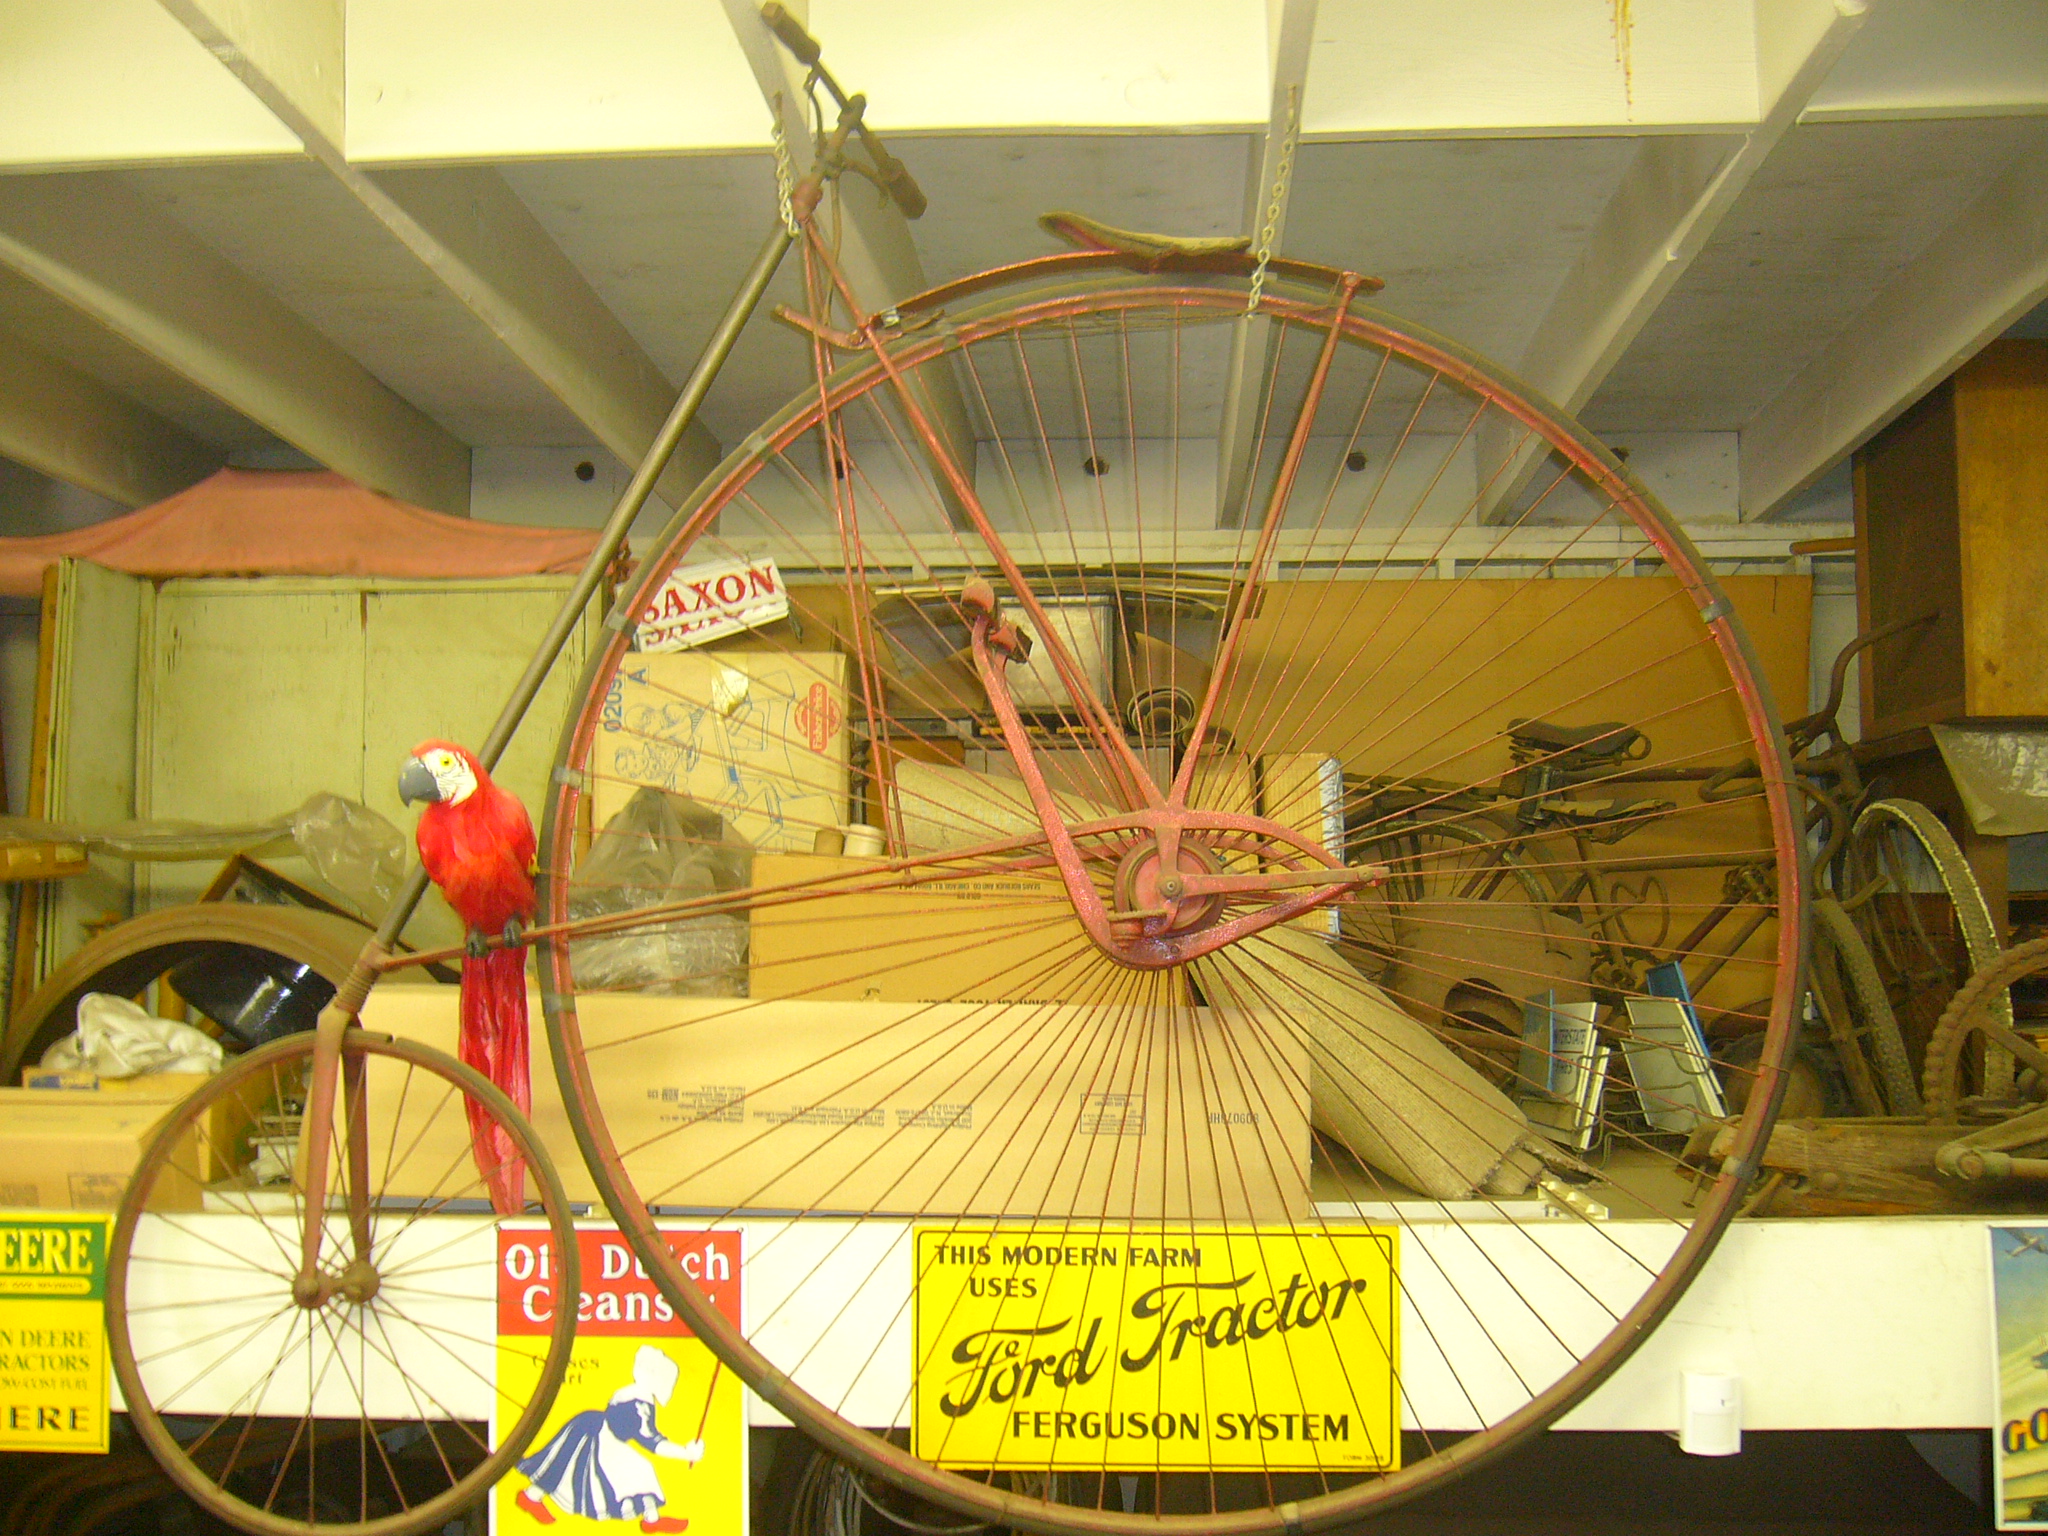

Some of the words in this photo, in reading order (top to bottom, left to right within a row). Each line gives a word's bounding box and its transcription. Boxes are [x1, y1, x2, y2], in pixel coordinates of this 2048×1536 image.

[628, 668, 646, 686] A
[504, 1243, 558, 1280] Ol
[601, 1241, 731, 1281] Duch
[934, 1245, 991, 1267] THIS
[1001, 1245, 1119, 1267] MODERN
[1129, 1246, 1202, 1268] FARM
[969, 1278, 1037, 1298] USES
[522, 1285, 716, 1323] Ceans
[939, 1314, 1107, 1418] Ford
[1120, 1270, 1367, 1373] Tractor
[1012, 1411, 1200, 1440] FERGUSON
[1215, 1413, 1350, 1442] SYSTEM
